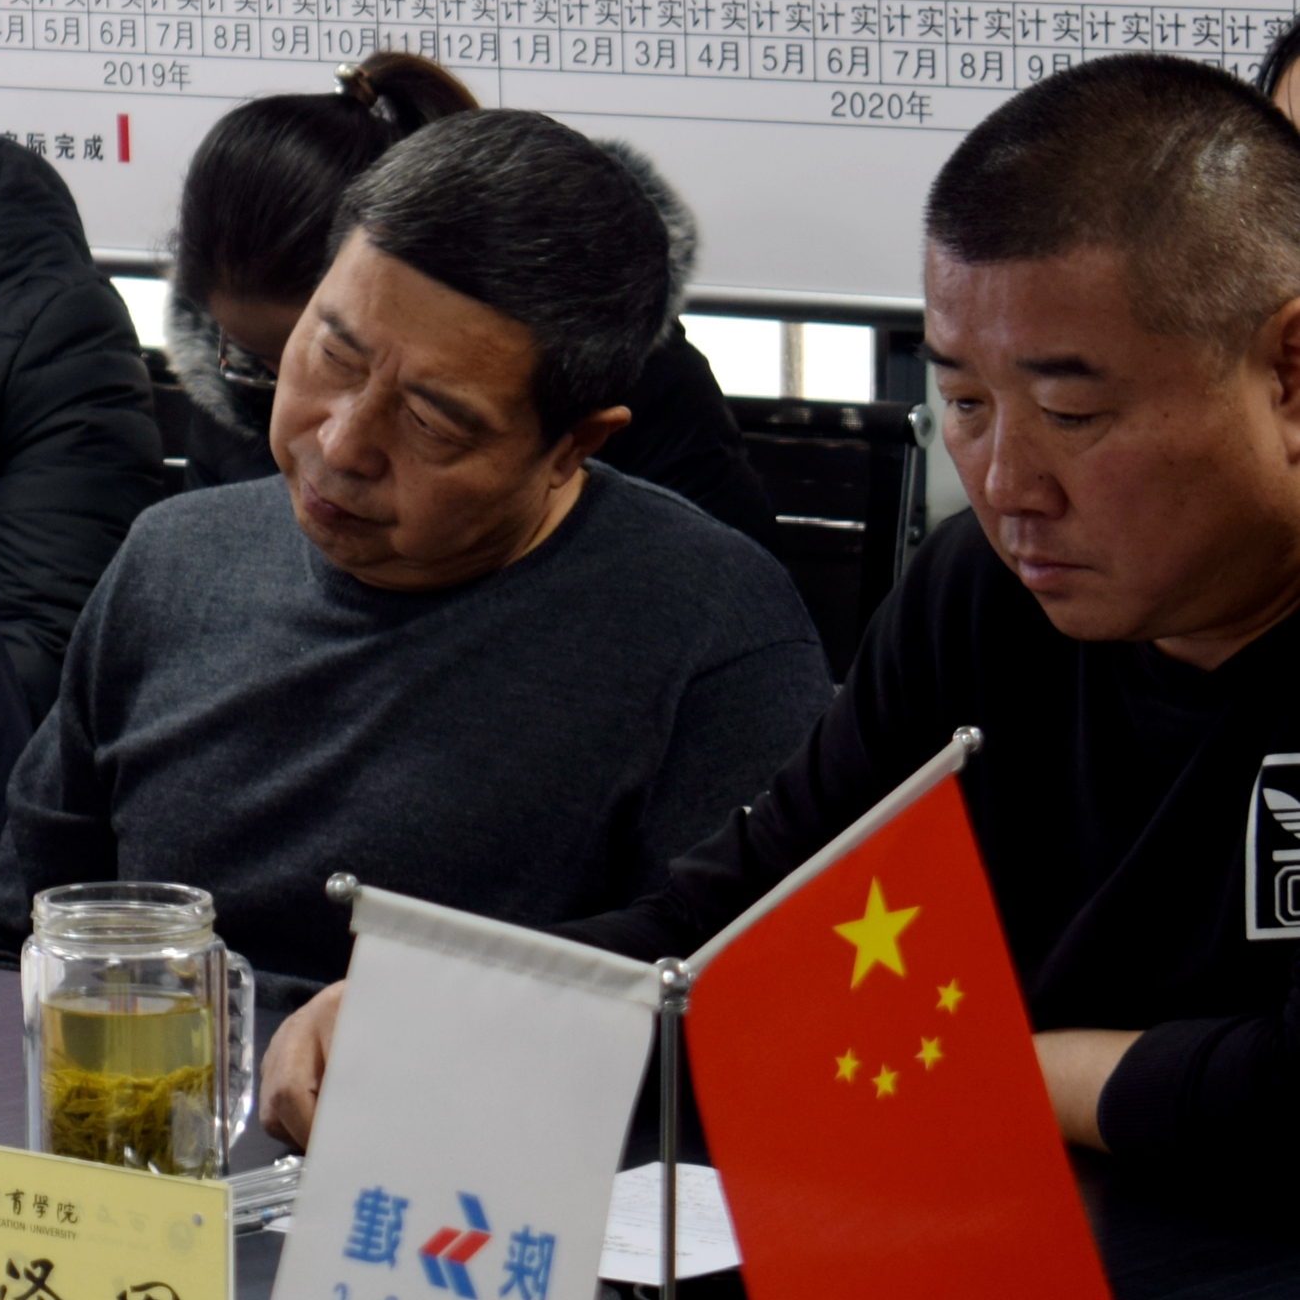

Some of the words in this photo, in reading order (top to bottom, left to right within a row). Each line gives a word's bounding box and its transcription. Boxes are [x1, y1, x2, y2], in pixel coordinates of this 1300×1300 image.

[44, 17, 80, 46] 5月
[100, 19, 137, 48] 6月
[156, 21, 193, 50] 7月
[214, 23, 251, 52] 8月
[272, 26, 309, 55] 9月
[324, 28, 376, 55] 10月
[443, 33, 498, 62] 12月
[513, 35, 550, 65] 1月
[573, 37, 613, 67] 2月
[635, 39, 676, 70] 3月
[698, 41, 740, 72] 4月
[762, 44, 804, 74] 5月
[827, 46, 870, 77] 6月
[895, 48, 936, 80] 7月
[960, 51, 1003, 82] 8月
[103, 60, 191, 91] 2019年
[831, 90, 933, 124] 2020年
[30, 1225, 77, 1241] UNIVERSITY
